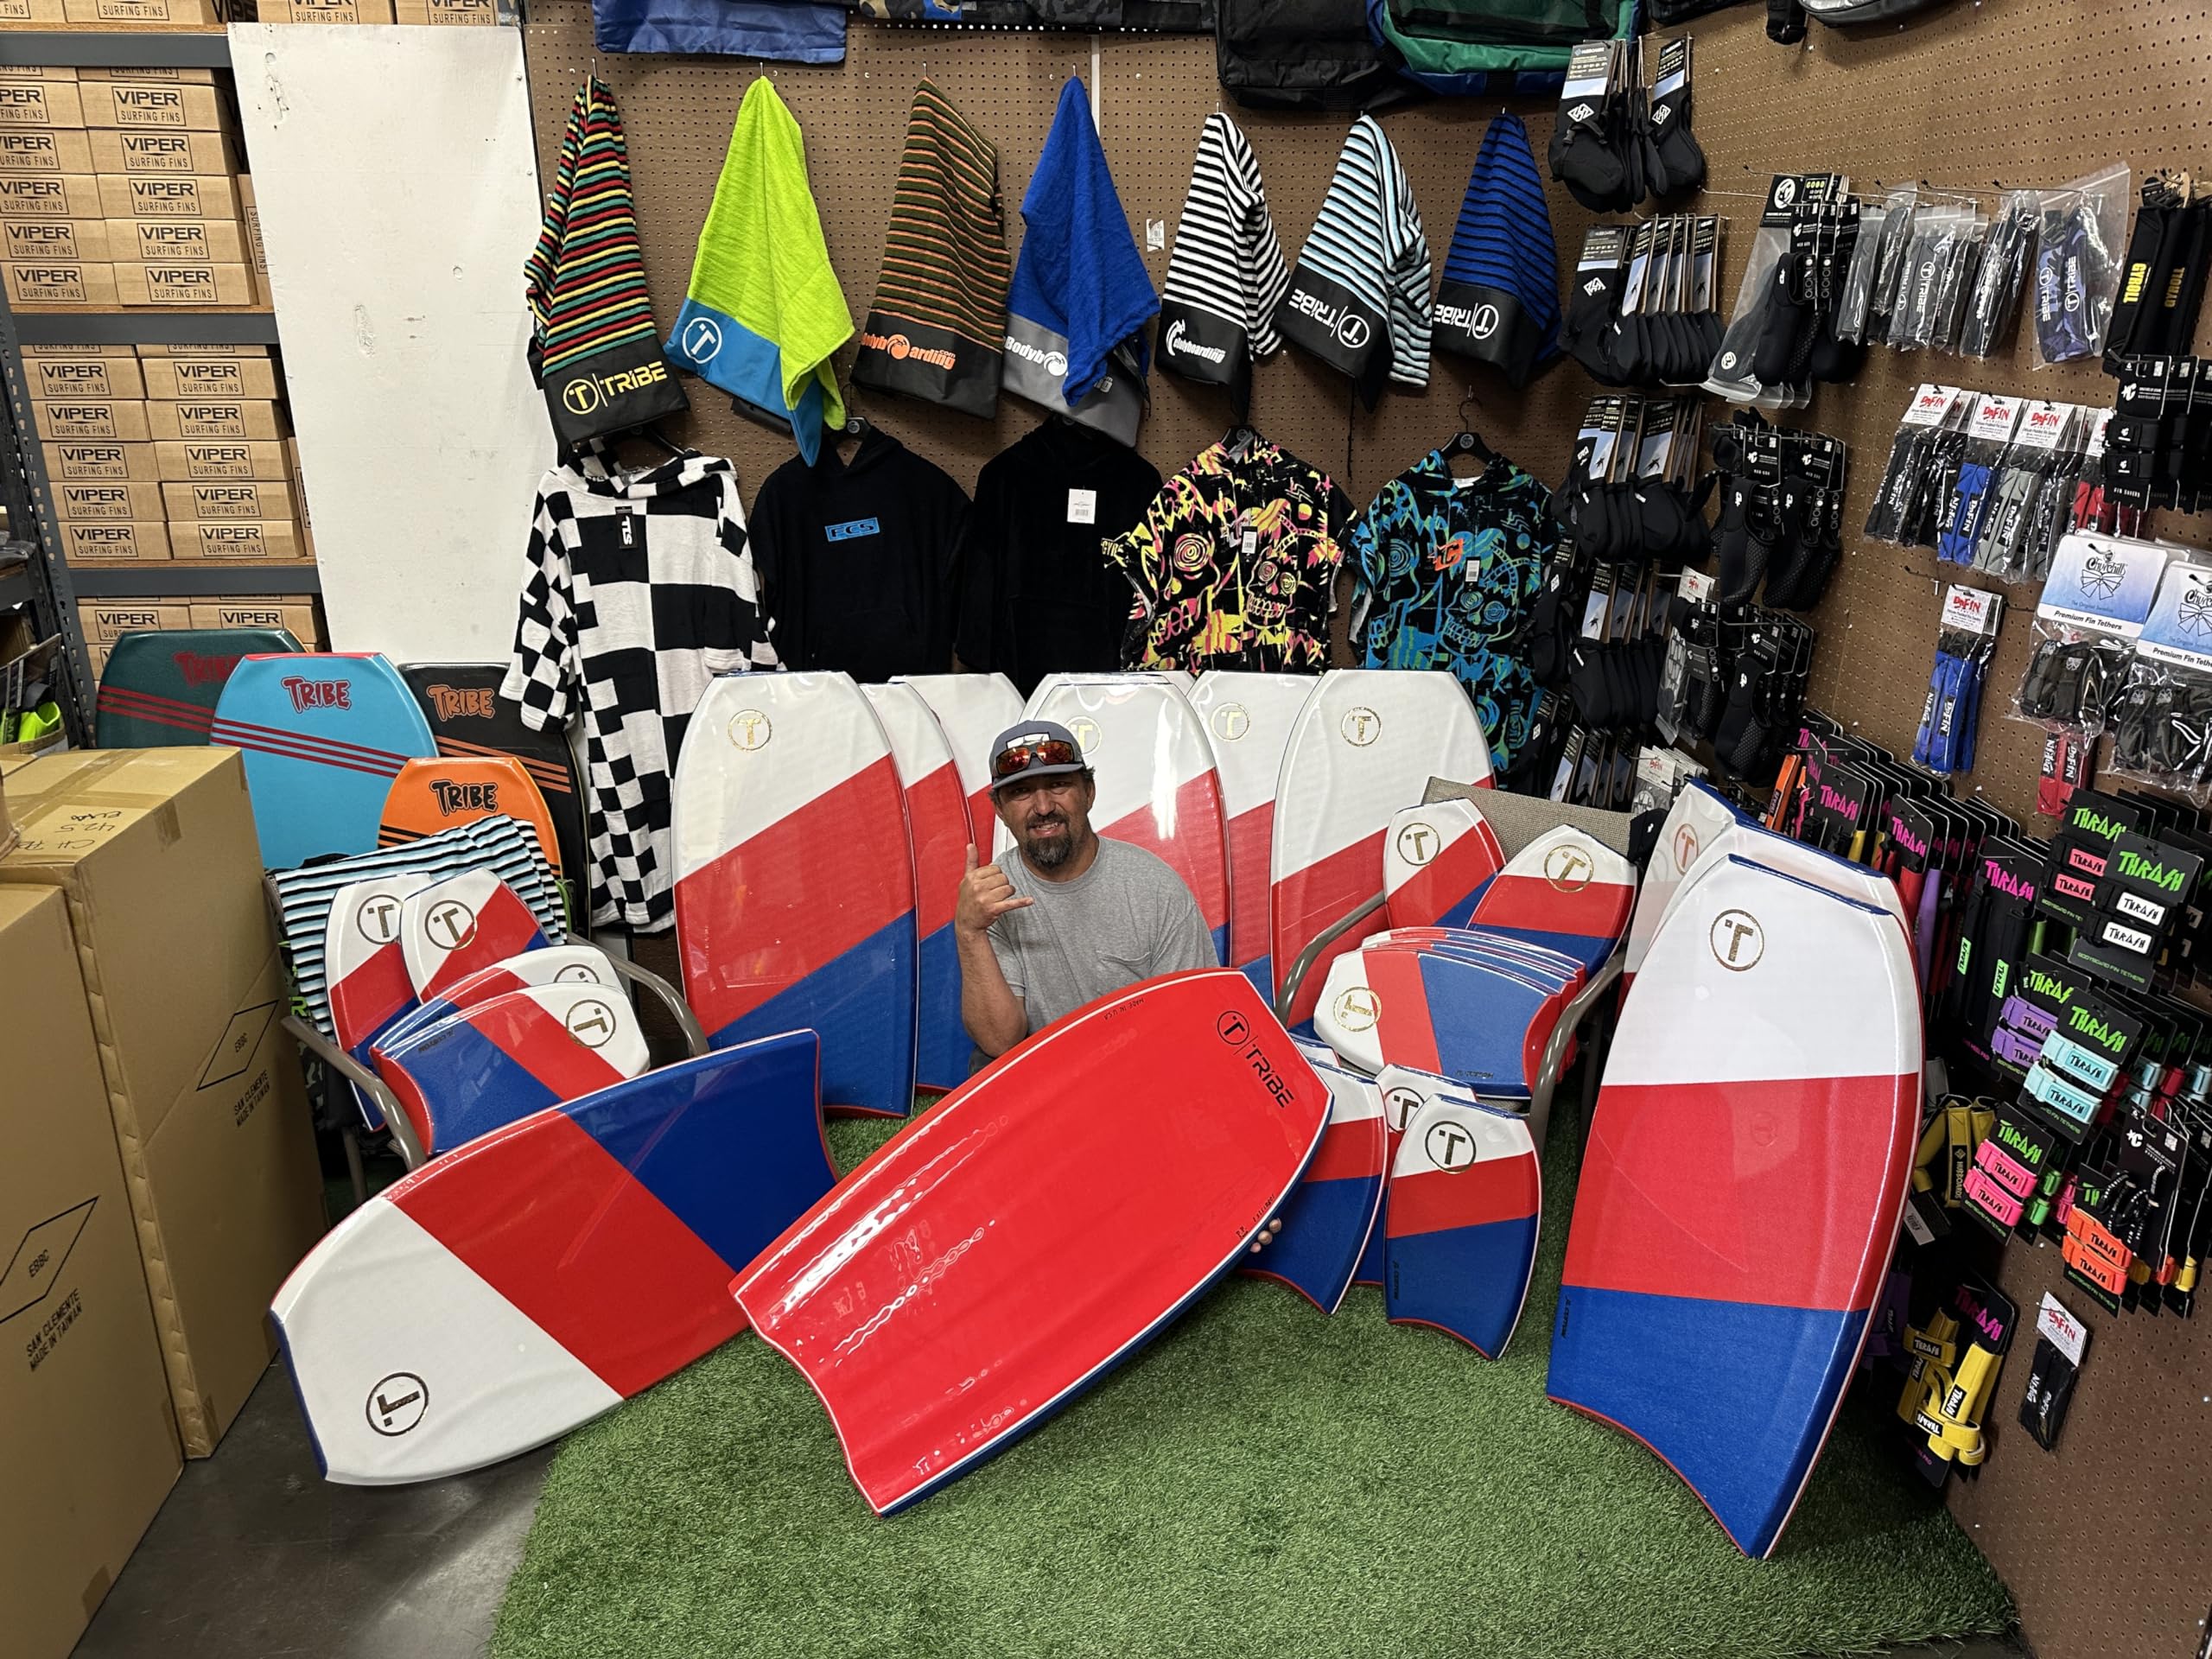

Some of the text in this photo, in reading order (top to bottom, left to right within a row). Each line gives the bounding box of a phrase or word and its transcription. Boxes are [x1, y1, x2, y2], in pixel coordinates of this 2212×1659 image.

[103, 5, 163, 17] SURFING FINS
[296, 11, 353, 22] SURFING FINS
[433, 14, 491, 24] SURFING FINS
[115, 91, 180, 105] VIPER
[24, 109, 43, 119] FINS
[120, 111, 181, 123] SURFING FINS
[124, 137, 187, 152] VIPER
[35, 156, 54, 166] FINS
[130, 156, 188, 168] SURFING FINS
[0, 181, 61, 195] VIPER
[132, 182, 194, 197] VIPER
[3, 200, 64, 211] SURFING FINS
[137, 201, 196, 213] SURFING FINS
[8, 226, 70, 240] VIPER
[140, 226, 203, 240] VIPER
[13, 244, 73, 255] SURFING FINS
[145, 245, 204, 256] SURFING FINS
[16, 269, 79, 283] VIPER
[149, 270, 211, 284] VIPER
[2066, 256, 2076, 291] TRIBE
[2122, 262, 2148, 304] GYROLL
[22, 288, 81, 298] SURFING FINS
[154, 288, 212, 299] SURFING FINS
[1916, 278, 1929, 313] TRIBE
[1288, 289, 1337, 327] TRIBE
[2040, 286, 2051, 322] TRIBE
[1434, 303, 1471, 327] TRIBE
[42, 365, 104, 378] VIPER
[176, 364, 238, 378] VIPER
[600, 361, 668, 397] TRIBE
[48, 383, 105, 393] SURFING FINS
[182, 383, 239, 393] SURFING FINS
[49, 406, 110, 420] VIPER
[179, 406, 239, 420] VIPER
[54, 424, 111, 435] SURFING FINS
[185, 424, 241, 435] SURFING FINS
[61, 448, 121, 461] VIPER
[188, 447, 247, 461] VIPER
[67, 465, 124, 476] SURFING FINS
[193, 465, 249, 476] SURFING FINS
[67, 488, 126, 502] VIPER
[196, 488, 254, 501] VIPER
[72, 505, 128, 516] SURFING FINS
[200, 505, 256, 516] SURFING FINS
[73, 528, 132, 541] VIPER
[201, 527, 259, 540] VIPER
[830, 522, 875, 537] FCS
[79, 544, 133, 555] SURFING FINS
[207, 543, 262, 554] SURFING FINS
[99, 613, 158, 626] VIPER
[222, 612, 280, 624] VIPER
[2054, 610, 2084, 622] Premium
[2097, 619, 2122, 630] Tethers
[2152, 646, 2183, 660] Premium
[2183, 654, 2196, 664] Fin
[281, 677, 352, 714] TRIBE
[427, 684, 495, 721] TRIBE
[429, 779, 499, 817] TRIBE
[1821, 785, 1859, 821] THRASH
[1892, 816, 1927, 858] THRASH
[2073, 854, 2104, 874] THRASH
[2119, 850, 2185, 893] THRASH
[1985, 860, 2035, 901] THRASH
[2058, 878, 2093, 898] THRASH
[2123, 897, 2160, 921] THRASH
[2108, 926, 2147, 949] THRASH
[2076, 951, 2145, 984] BODYBOARD FIN TETHERS
[2070, 1006, 2127, 1052] THRASH
[2070, 1055, 2102, 1078] THRASH
[1244, 1043, 1294, 1109] TRIBE
[234, 1069, 269, 1116] SAN CLEMENTE
[2050, 1090, 2084, 1114] THRASH
[235, 1109, 250, 1128] MADE
[1998, 1120, 2044, 1166] THRASH
[1994, 1162, 2019, 1186] THRASH
[1978, 1188, 2004, 1213] THRASH
[2090, 1231, 2118, 1259] THRASH
[29, 1249, 50, 1279] EBBC
[2079, 1258, 2107, 1285] THRASH
[27, 1287, 79, 1357] SAN CLEMENTE
[29, 1301, 82, 1373] MADE IN TAIWAN
[1913, 1339, 1941, 1357] THRASH
[1945, 1388, 1964, 1416] THRASH
[1916, 1413, 1941, 1435] THRASH
